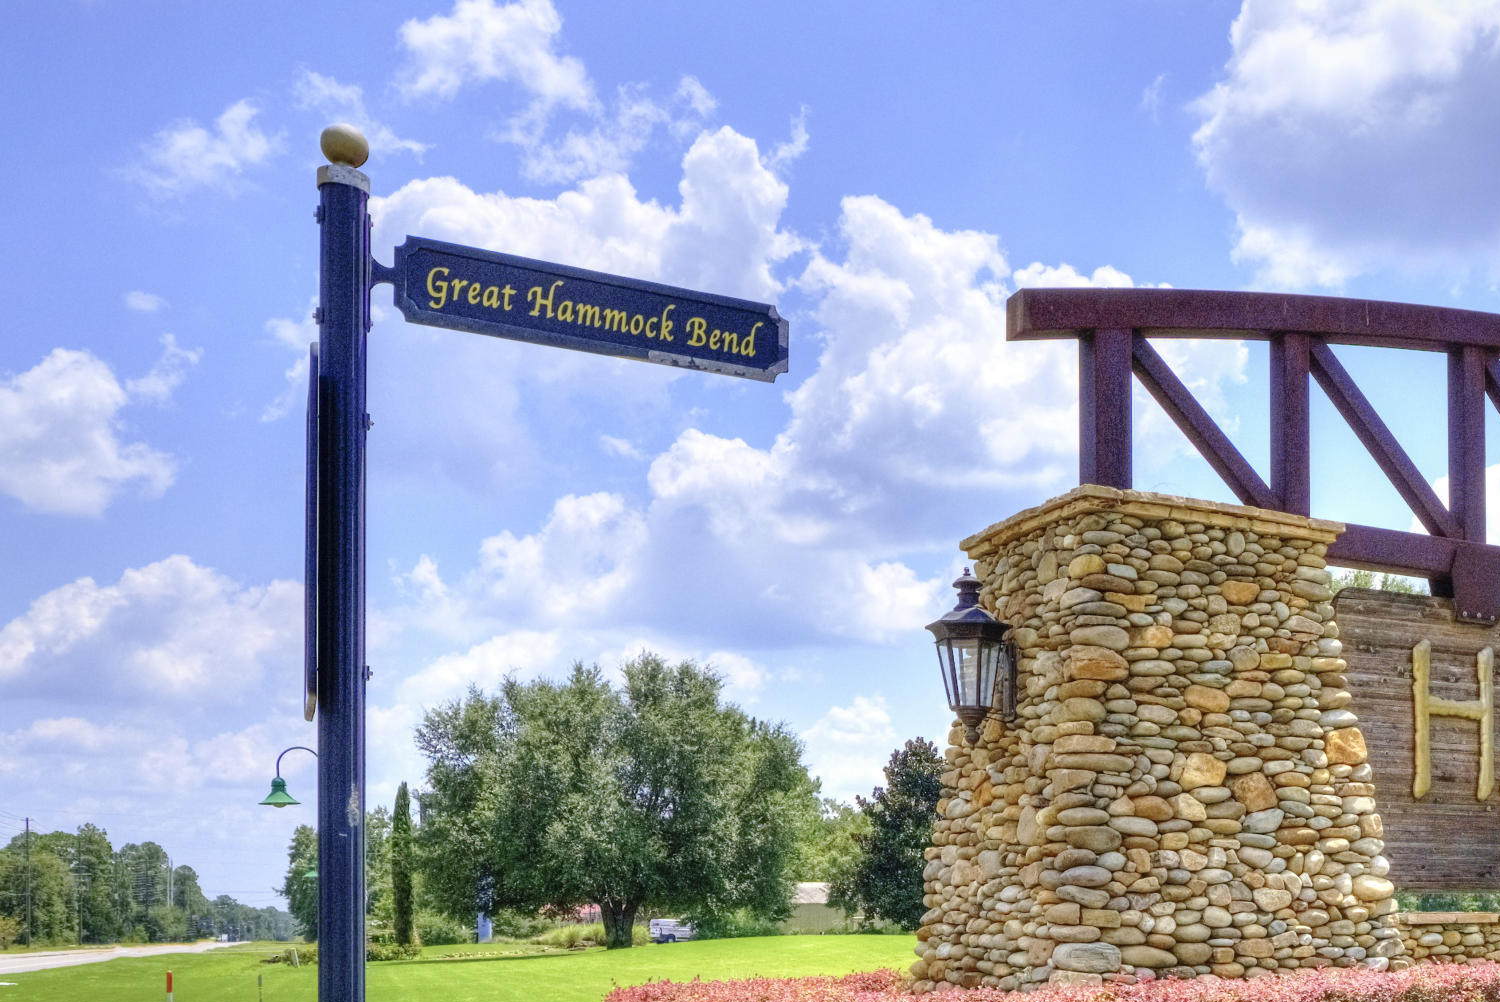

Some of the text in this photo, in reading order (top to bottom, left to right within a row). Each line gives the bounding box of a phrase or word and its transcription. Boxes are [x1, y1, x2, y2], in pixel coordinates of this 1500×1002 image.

[426, 267, 764, 358] Great Hammock Bend
